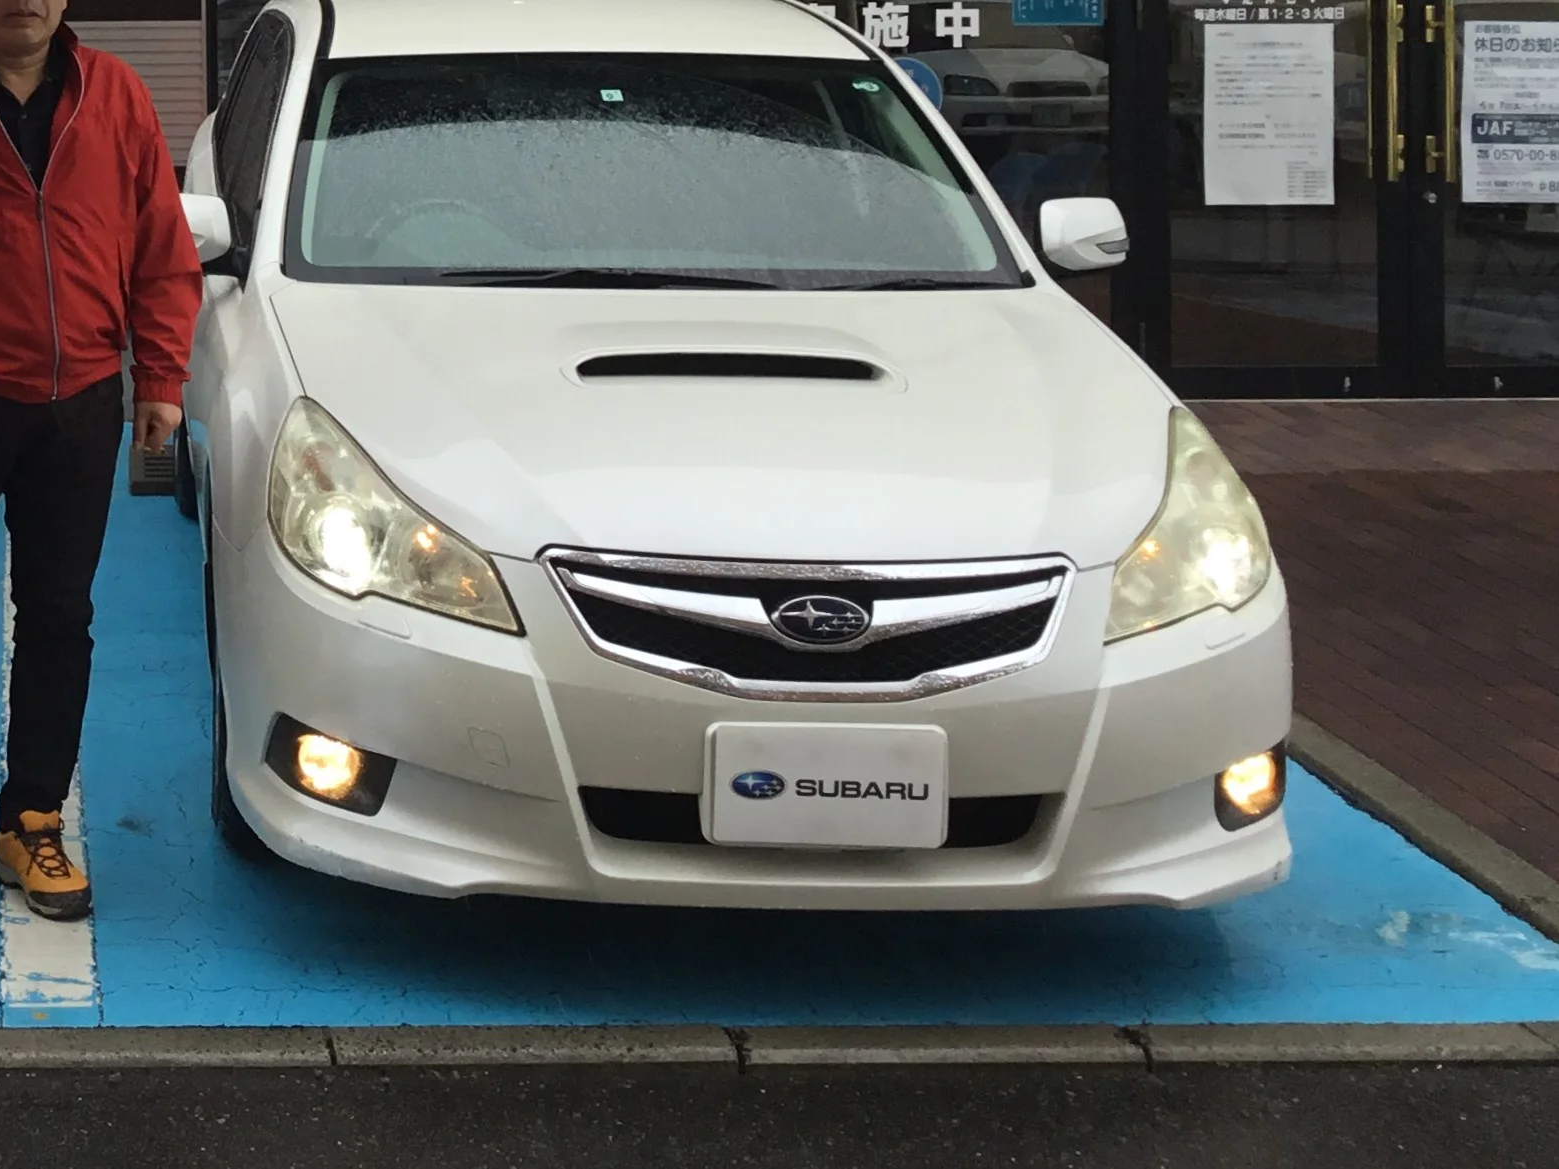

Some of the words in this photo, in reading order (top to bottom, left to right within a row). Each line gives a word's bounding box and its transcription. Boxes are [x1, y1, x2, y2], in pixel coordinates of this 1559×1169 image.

[807, 1, 981, 48] 施中
[1477, 120, 1513, 136] JAF
[1493, 148, 1559, 161] 0570-00-8
[795, 778, 930, 801] SUBARU
